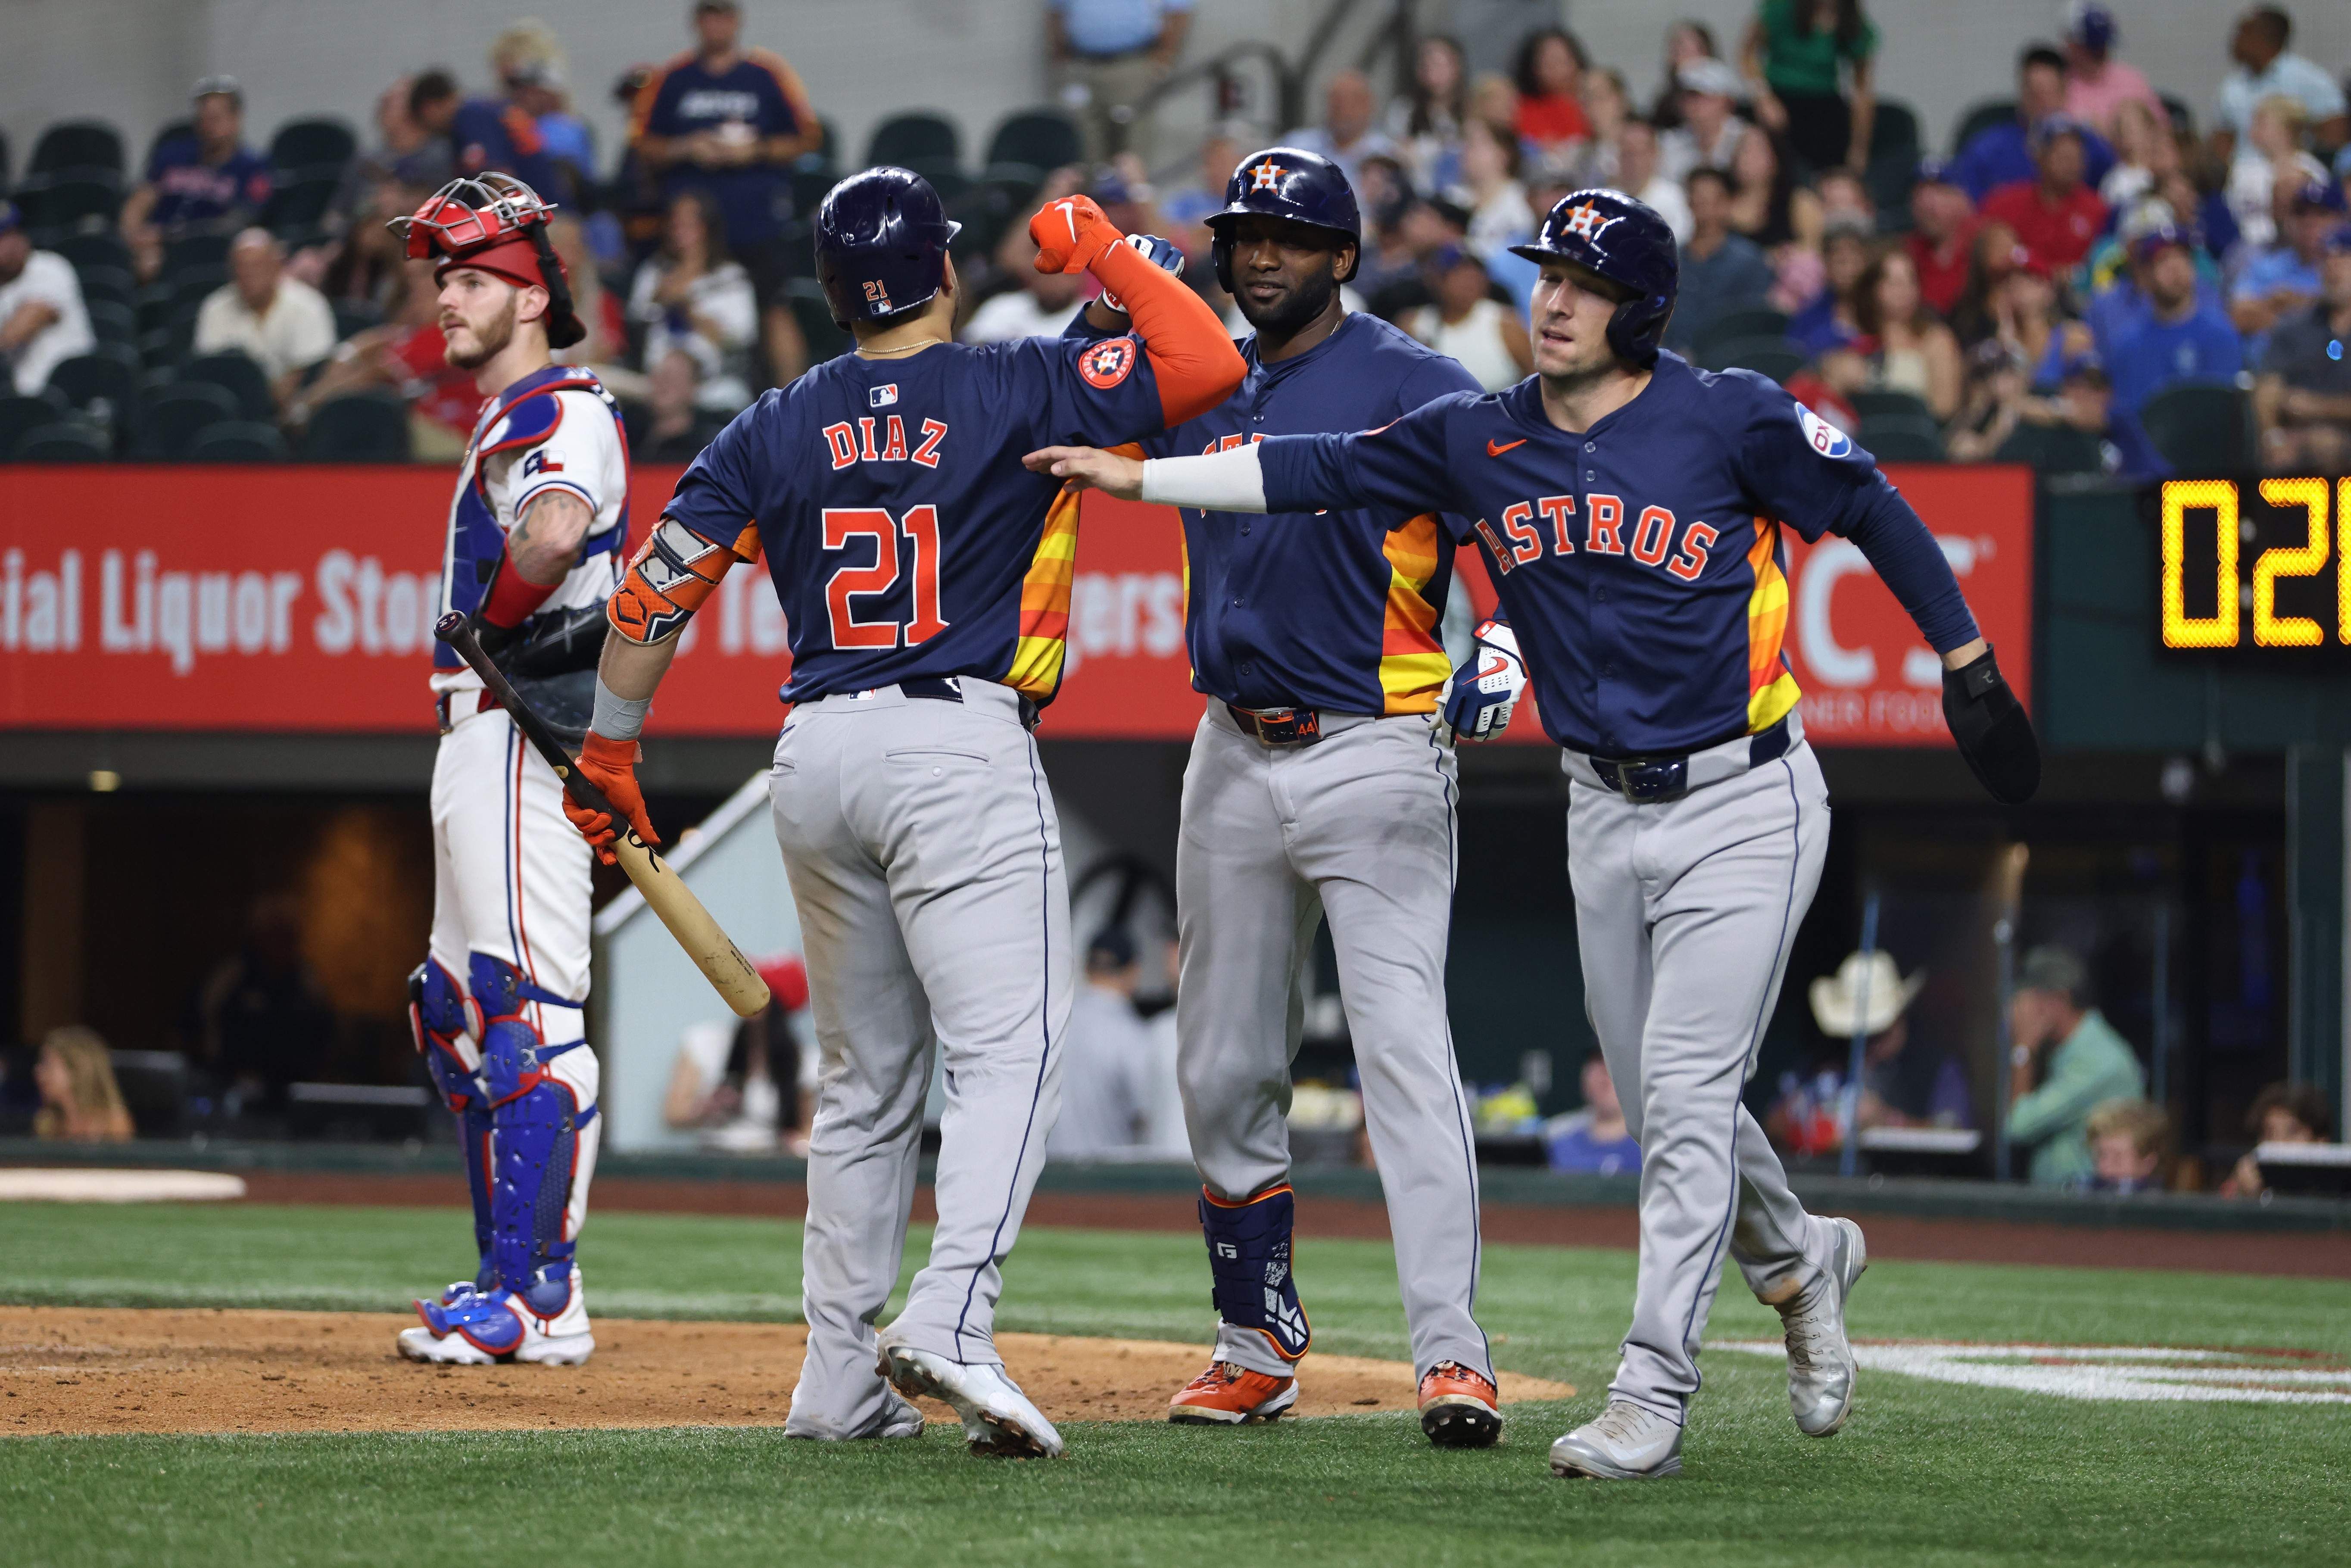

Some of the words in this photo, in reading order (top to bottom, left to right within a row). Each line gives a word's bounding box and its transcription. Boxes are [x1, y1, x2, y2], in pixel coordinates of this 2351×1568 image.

[862, 279, 888, 301] 21
[1083, 344, 1107, 380] HOUSTON
[1115, 344, 1132, 380] ASTROS
[822, 414, 948, 471] DIAZ
[687, 546, 716, 564] EVOSHIELD
[1474, 493, 1720, 583] ASTROS
[821, 504, 951, 651] 21
[2162, 477, 2351, 648] 02
[661, 574, 690, 591] EVOSHIELD
[0, 546, 83, 654] ial
[98, 546, 304, 677] Liquor
[439, 618, 448, 628] 14
[1298, 721, 1316, 736] 44
